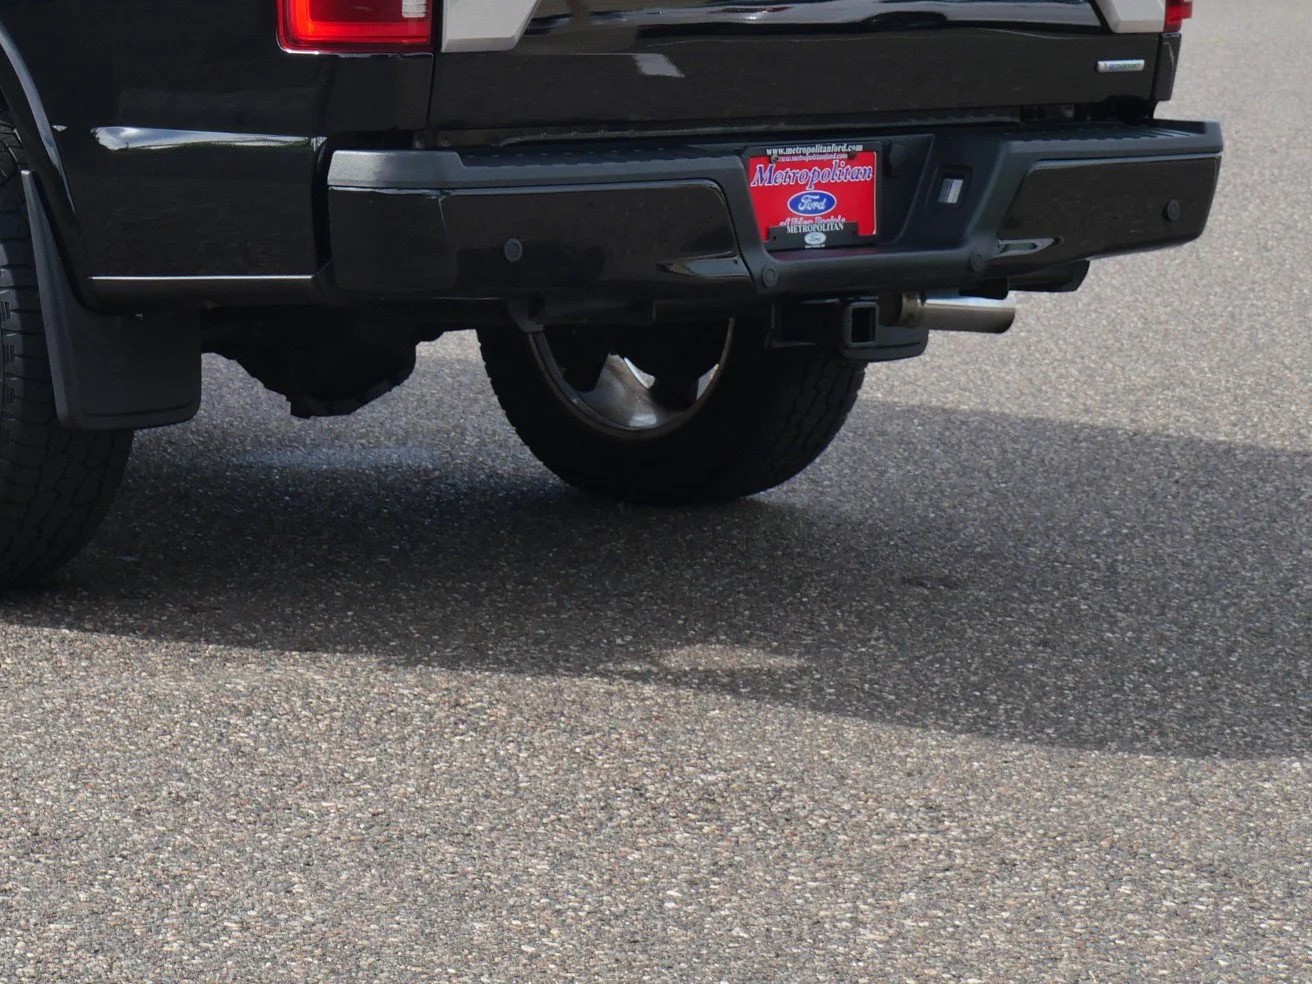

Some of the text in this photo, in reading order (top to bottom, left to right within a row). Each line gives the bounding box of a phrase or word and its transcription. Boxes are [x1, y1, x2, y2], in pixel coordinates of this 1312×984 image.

[766, 143, 863, 156] www.metropolitanford.com
[750, 160, 873, 190] Metropolitan
[798, 195, 827, 211] Ford
[786, 222, 844, 234] METROPOLITAN
